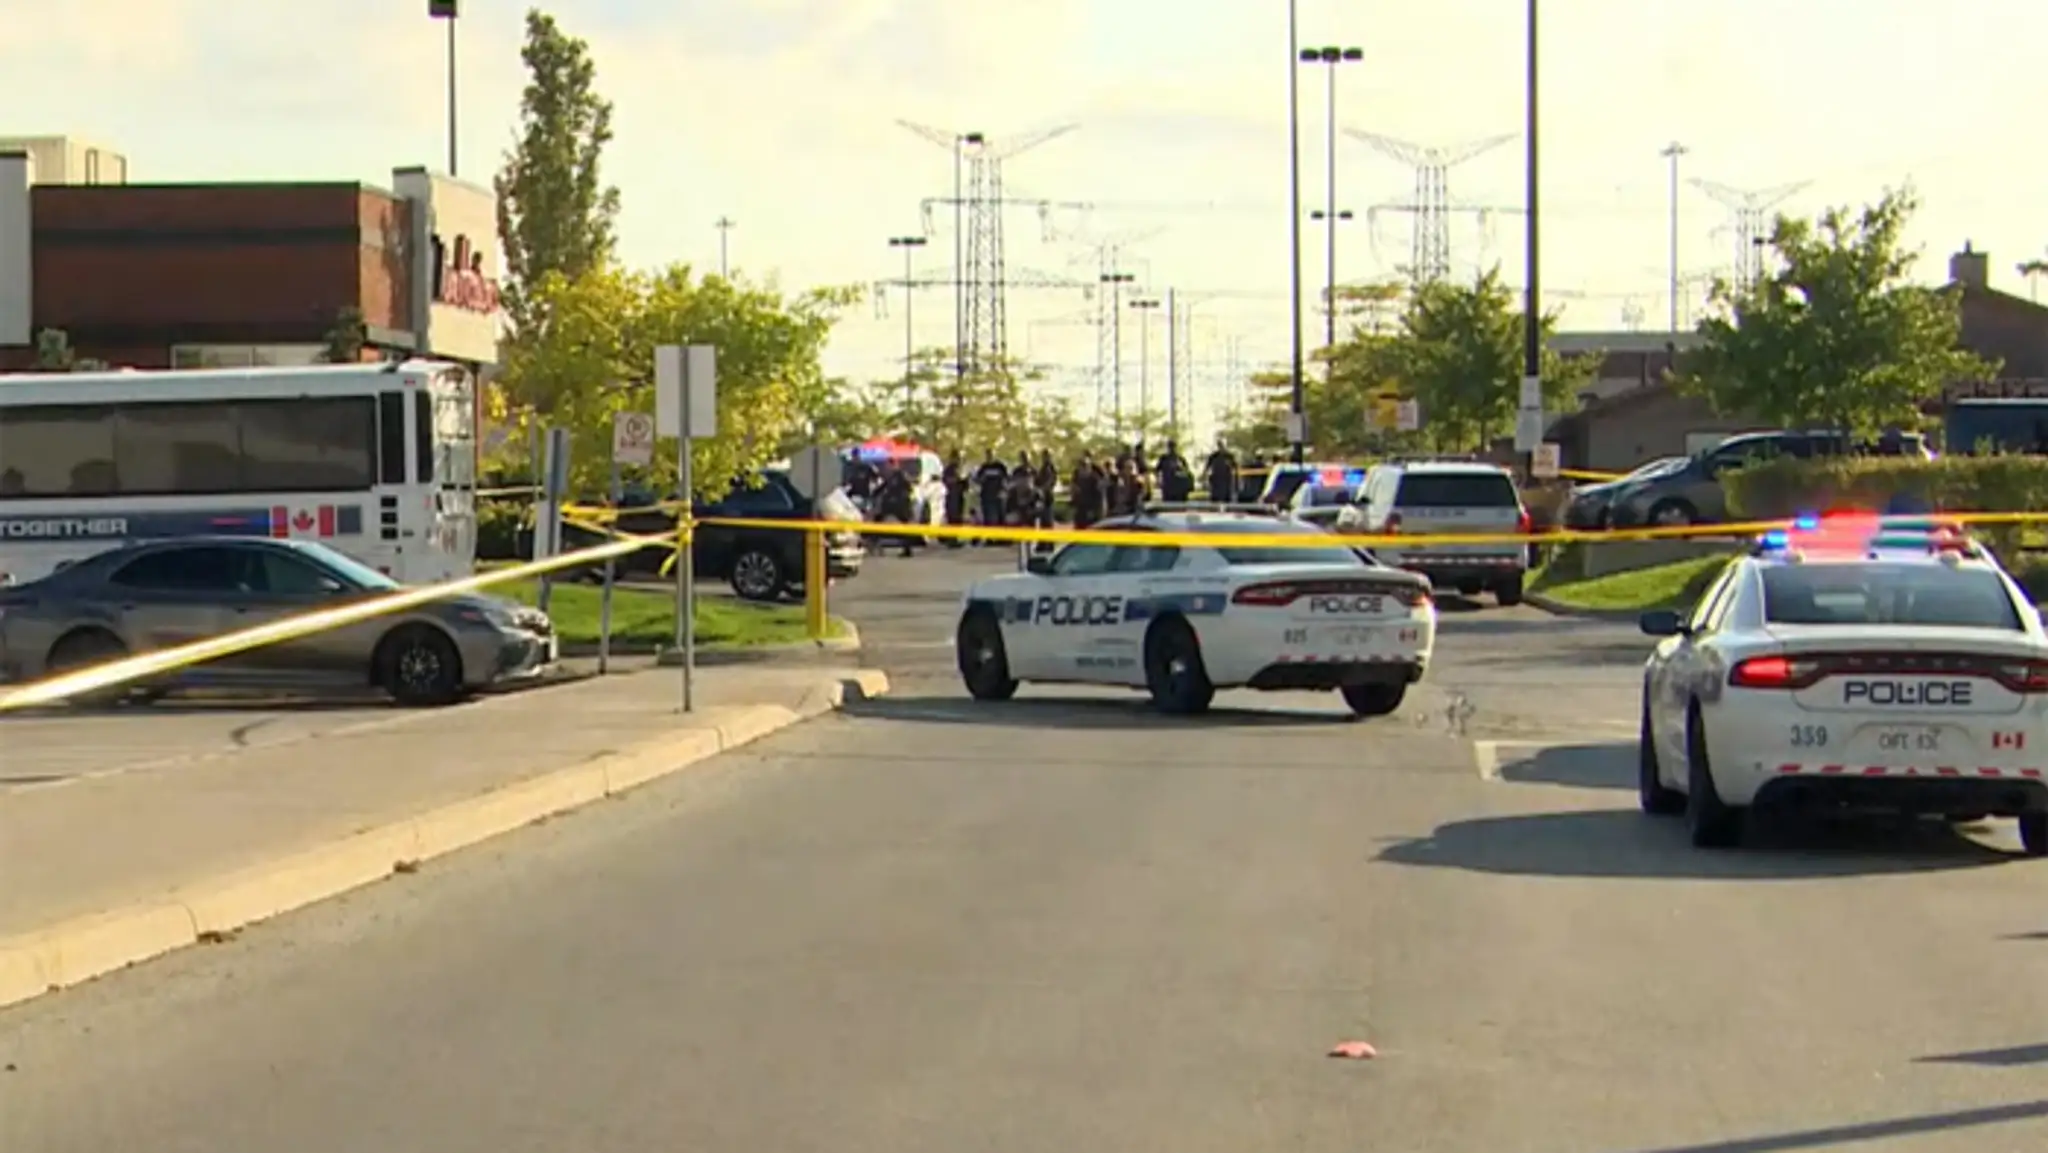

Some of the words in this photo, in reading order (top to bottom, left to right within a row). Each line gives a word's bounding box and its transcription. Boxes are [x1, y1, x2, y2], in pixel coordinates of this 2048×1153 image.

[1035, 595, 1123, 625] POLICE
[1310, 597, 1382, 613] POLICE
[1843, 681, 1973, 705] POLICE
[1790, 725, 1828, 748] 359
